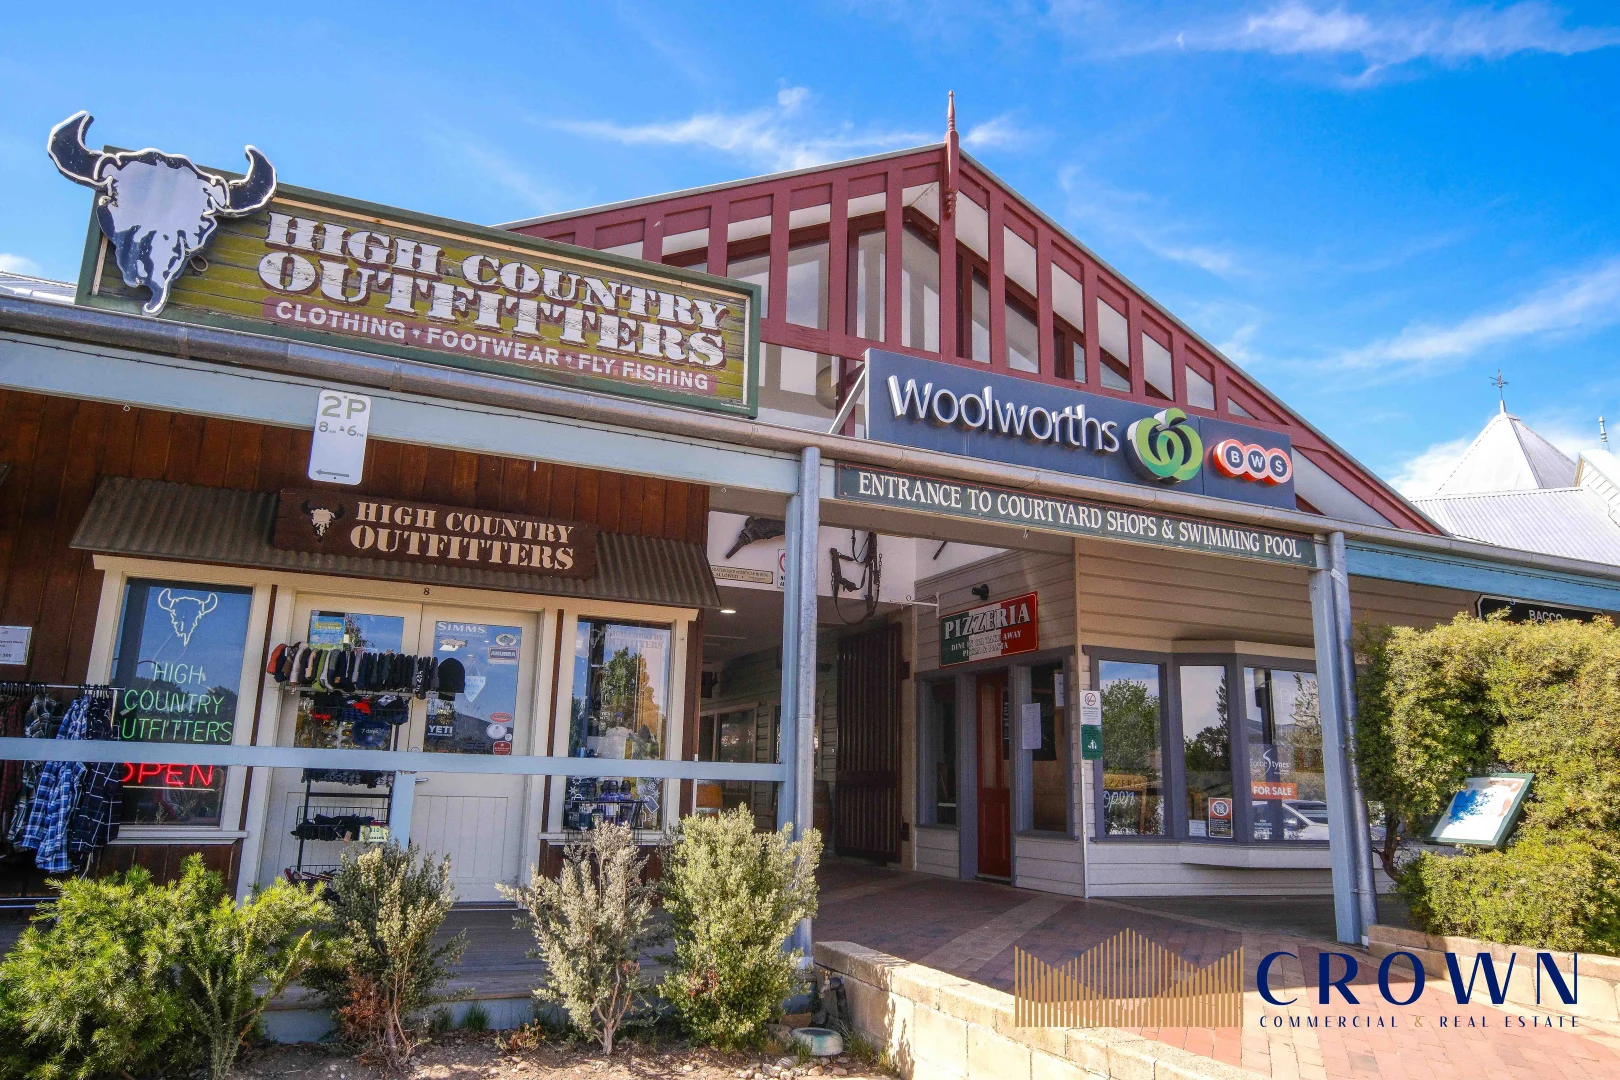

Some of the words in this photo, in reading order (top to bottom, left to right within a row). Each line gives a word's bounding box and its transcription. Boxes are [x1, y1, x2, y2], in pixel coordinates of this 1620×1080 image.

[265, 211, 445, 281] HIGH
[461, 255, 729, 334] COUNTRY
[258, 251, 727, 370] OUTFITTERS
[276, 302, 406, 339] CLOTHING
[427, 328, 558, 365] FOOTWEAR
[579, 354, 615, 374] FLY
[622, 362, 708, 391] FISHING
[321, 395, 366, 419] 2P
[887, 375, 1119, 452] Woolworths
[355, 501, 436, 529] HIGH
[446, 512, 574, 543] COUNTRY
[858, 471, 962, 508] ENTRANCE
[967, 488, 991, 512] TO
[997, 493, 1101, 529] COURTYARD
[1106, 510, 1157, 537] SHOPS
[1161, 518, 1174, 540] &
[1179, 521, 1260, 552] SWIMMING
[1263, 534, 1302, 558] POOL
[350, 525, 574, 570] OUTFITTERS
[424, 587, 429, 595] 8
[437, 621, 485, 634] SIMMS
[944, 602, 1031, 640] PIZZERIA
[951, 642, 966, 651] DINE
[1002, 630, 1022, 640] AWAY
[153, 662, 203, 684] HIGH
[124, 689, 224, 715] COUNTRY
[121, 718, 233, 742] UTFITTERS
[429, 724, 453, 734] YETI
[1253, 786, 1271, 796] FOR
[1272, 786, 1292, 796] SALE
